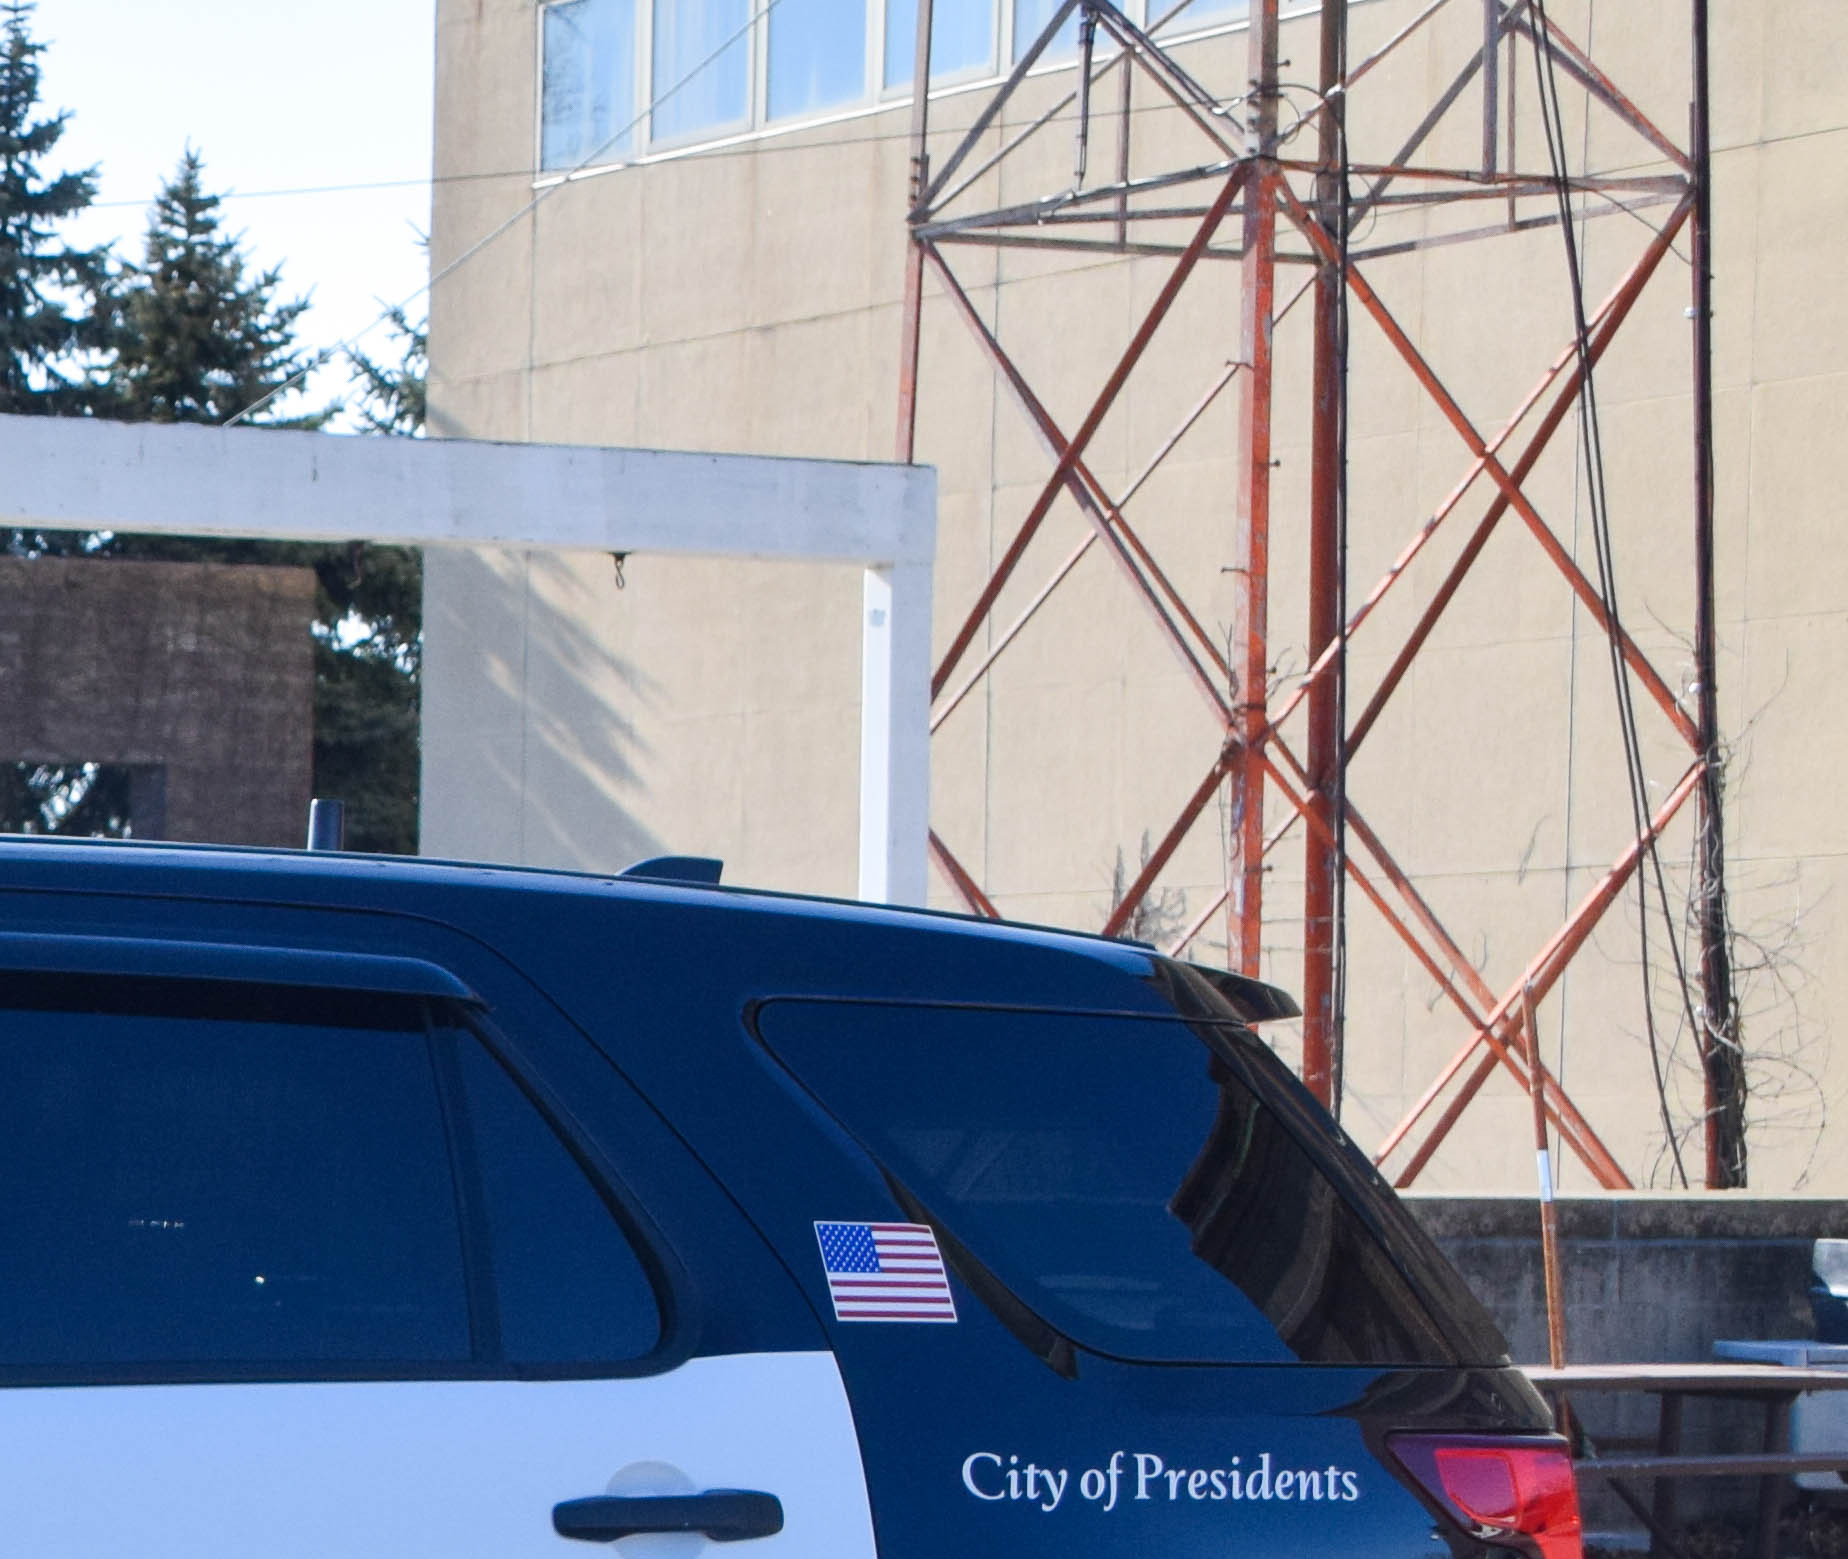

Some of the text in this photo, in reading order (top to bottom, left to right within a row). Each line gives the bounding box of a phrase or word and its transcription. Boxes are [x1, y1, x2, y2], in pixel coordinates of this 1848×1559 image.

[961, 1450, 1360, 1512] City of Presidents
